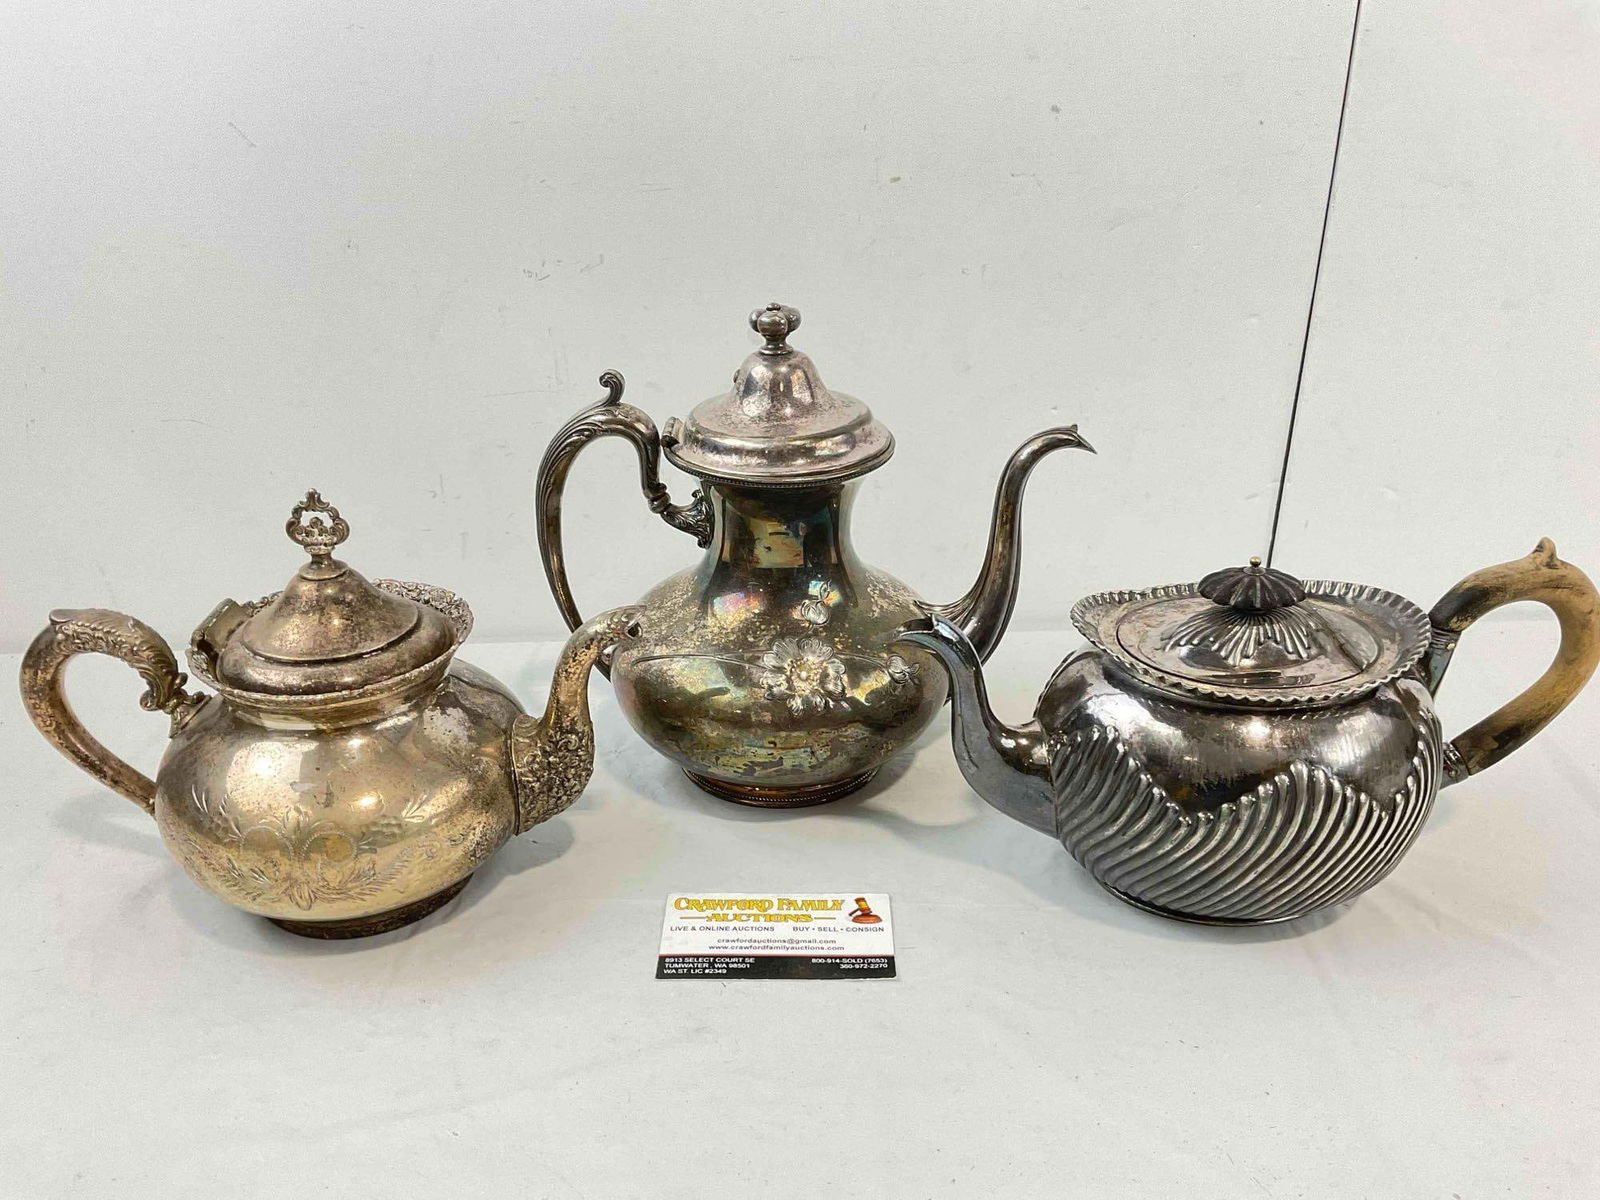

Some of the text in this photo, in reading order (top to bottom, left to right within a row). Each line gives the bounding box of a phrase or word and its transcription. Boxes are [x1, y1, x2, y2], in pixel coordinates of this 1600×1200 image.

[674, 897, 846, 912] CRAWFORD FAMILY
[706, 913, 814, 922] AUCTIONS
